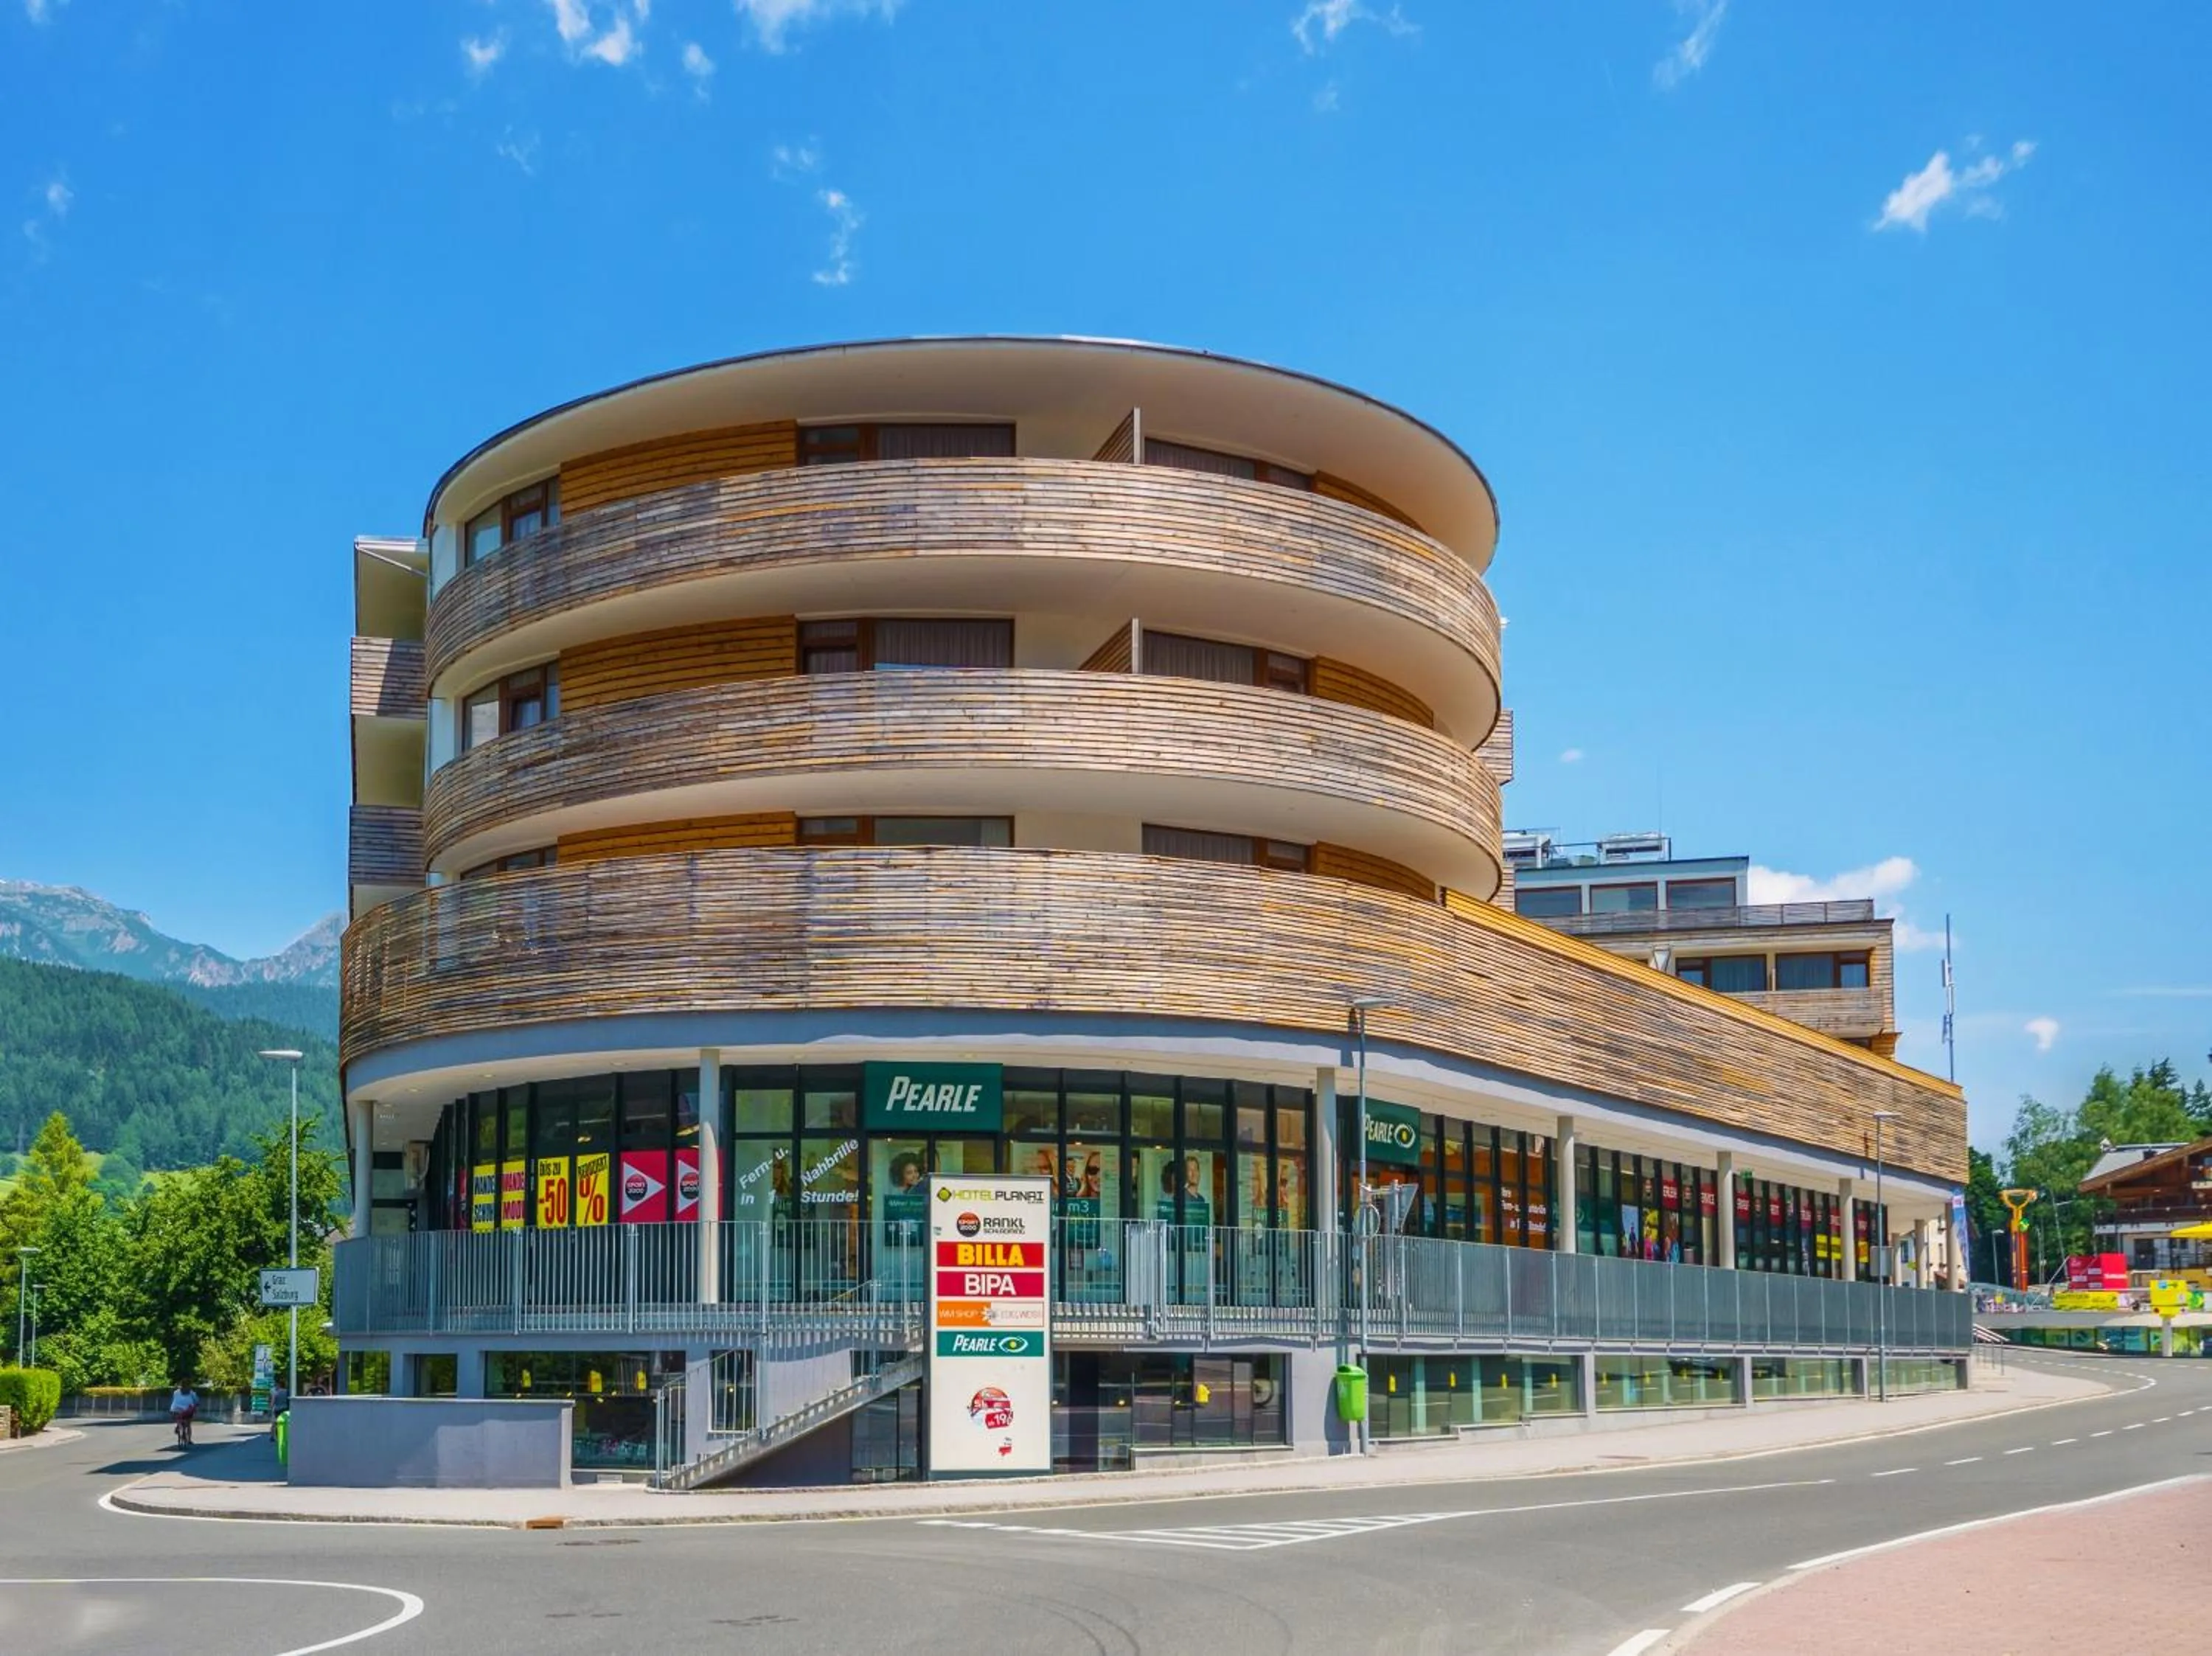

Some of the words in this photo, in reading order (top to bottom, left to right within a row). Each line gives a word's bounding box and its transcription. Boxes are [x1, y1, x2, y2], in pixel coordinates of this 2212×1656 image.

[886, 1076, 982, 1112] PEARLE
[801, 1139, 859, 1186] Nahbrille
[539, 1177, 567, 1225] -50
[740, 1192, 755, 1206] in
[801, 1190, 859, 1203] Stunde!
[983, 1217, 1025, 1228] RANKL
[957, 1244, 1024, 1266] BILLA
[964, 1273, 1017, 1295] BIPA
[953, 1334, 997, 1351] PEARLE
